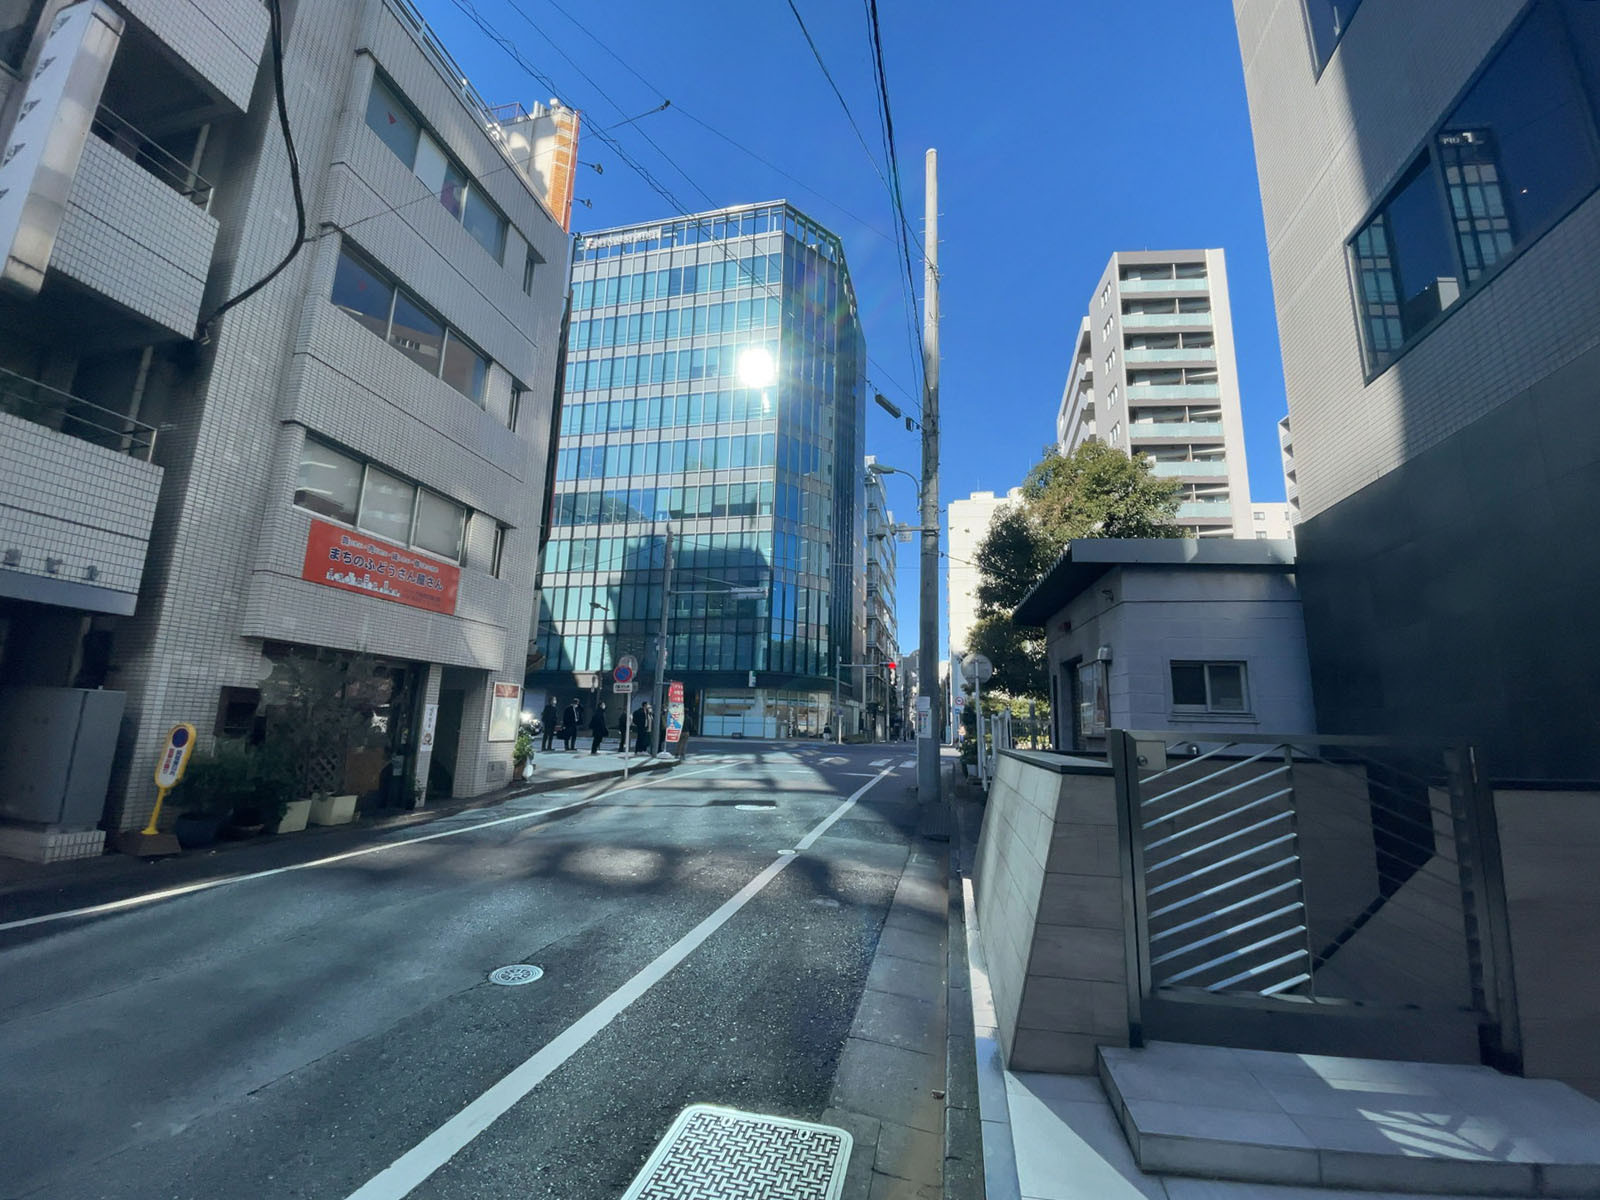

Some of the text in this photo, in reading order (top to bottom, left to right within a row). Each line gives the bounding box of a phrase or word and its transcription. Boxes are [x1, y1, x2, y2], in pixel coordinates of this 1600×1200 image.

[328, 548, 443, 591] まちのふどうさん屋さん
